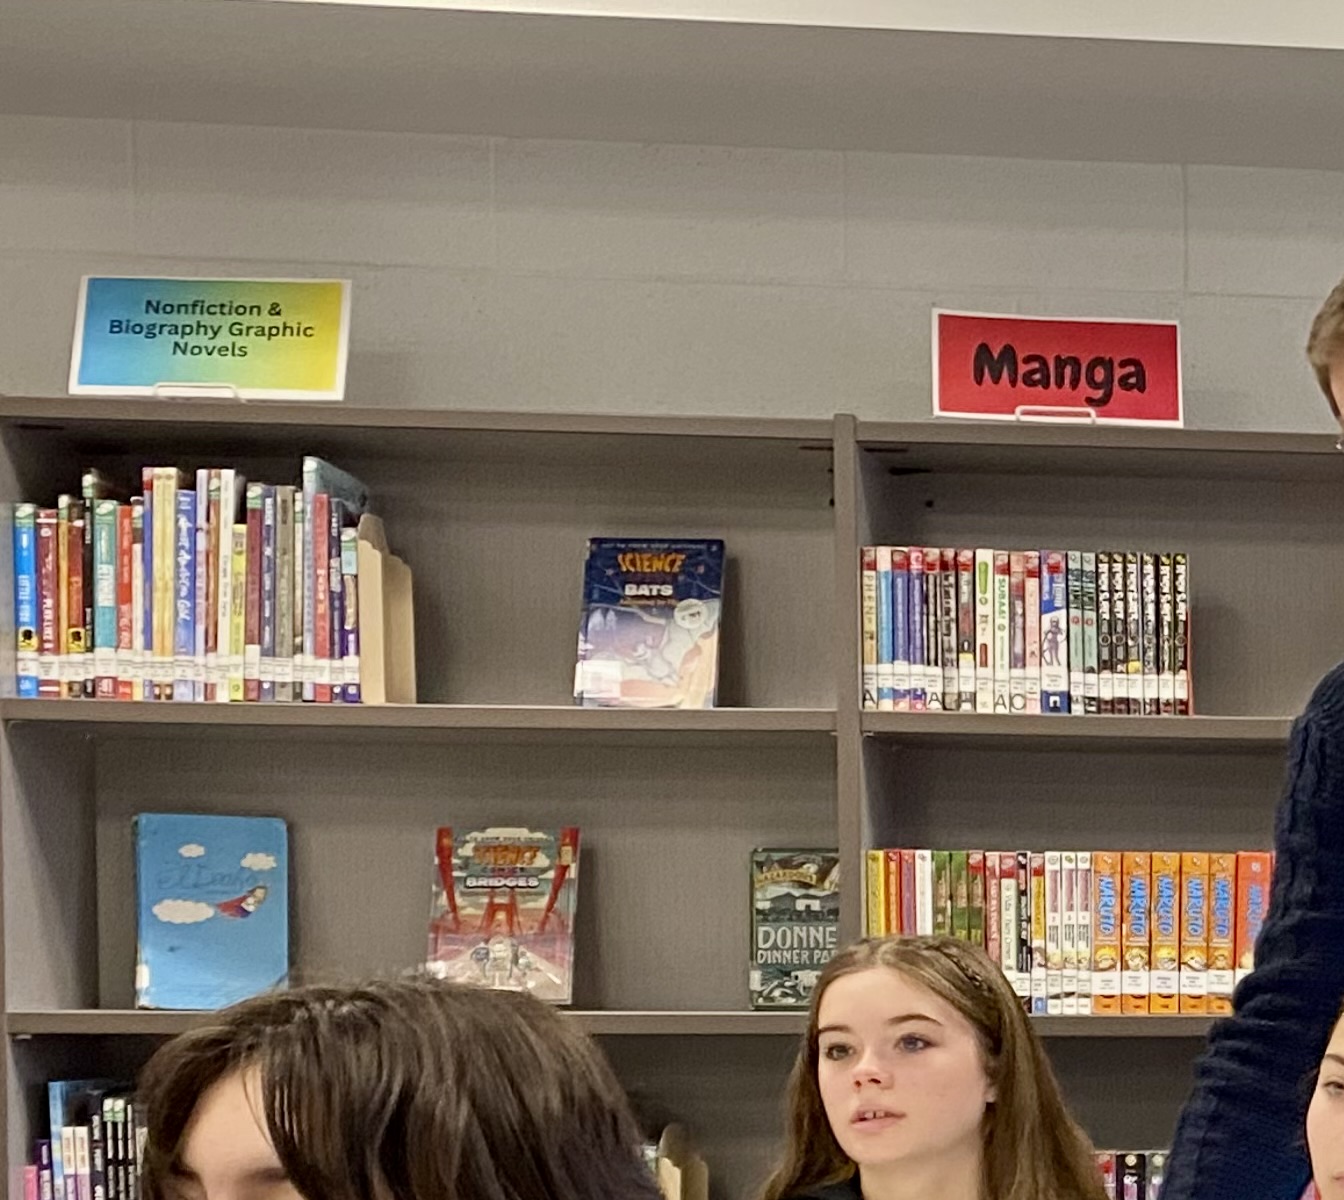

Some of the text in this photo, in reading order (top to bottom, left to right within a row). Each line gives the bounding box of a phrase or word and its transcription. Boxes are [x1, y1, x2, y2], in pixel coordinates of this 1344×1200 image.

[144, 299, 283, 318] Nonfiction &
[108, 318, 314, 340] Biography Graphic
[172, 341, 248, 359] Novels
[973, 342, 1147, 407] Manga
[617, 552, 686, 573] SCIENCE
[624, 584, 674, 597] BATS
[465, 877, 540, 888] BRIDGES
[1099, 875, 1117, 934] NARUTO
[1129, 876, 1145, 935] NARUTO
[1158, 875, 1174, 934] NARUTO
[1187, 878, 1203, 936] NARUTO
[1215, 879, 1231, 937] NARUTO
[758, 926, 837, 949] DONNE
[757, 950, 810, 964] DINNER
